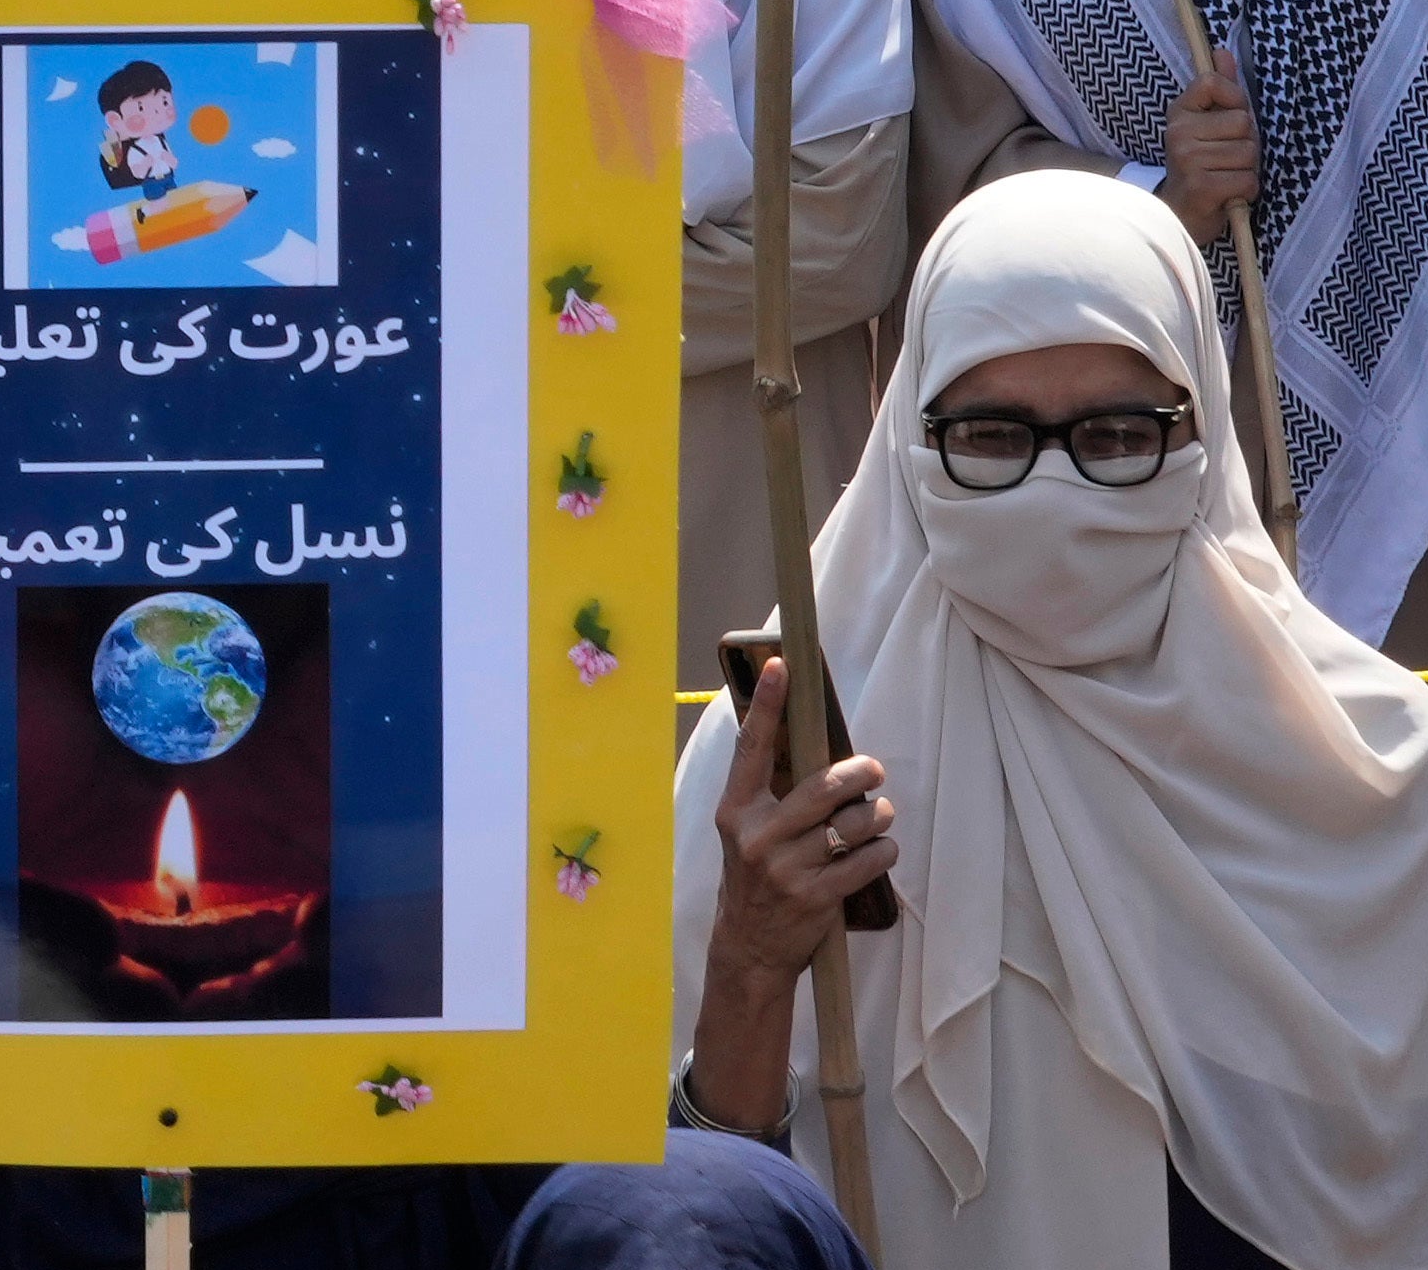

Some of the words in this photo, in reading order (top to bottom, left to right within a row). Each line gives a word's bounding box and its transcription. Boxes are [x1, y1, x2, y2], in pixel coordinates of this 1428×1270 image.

[118, 304, 212, 377] کی
[229, 313, 410, 375] عورت
[145, 506, 238, 578] کی
[253, 502, 408, 577] نسل
